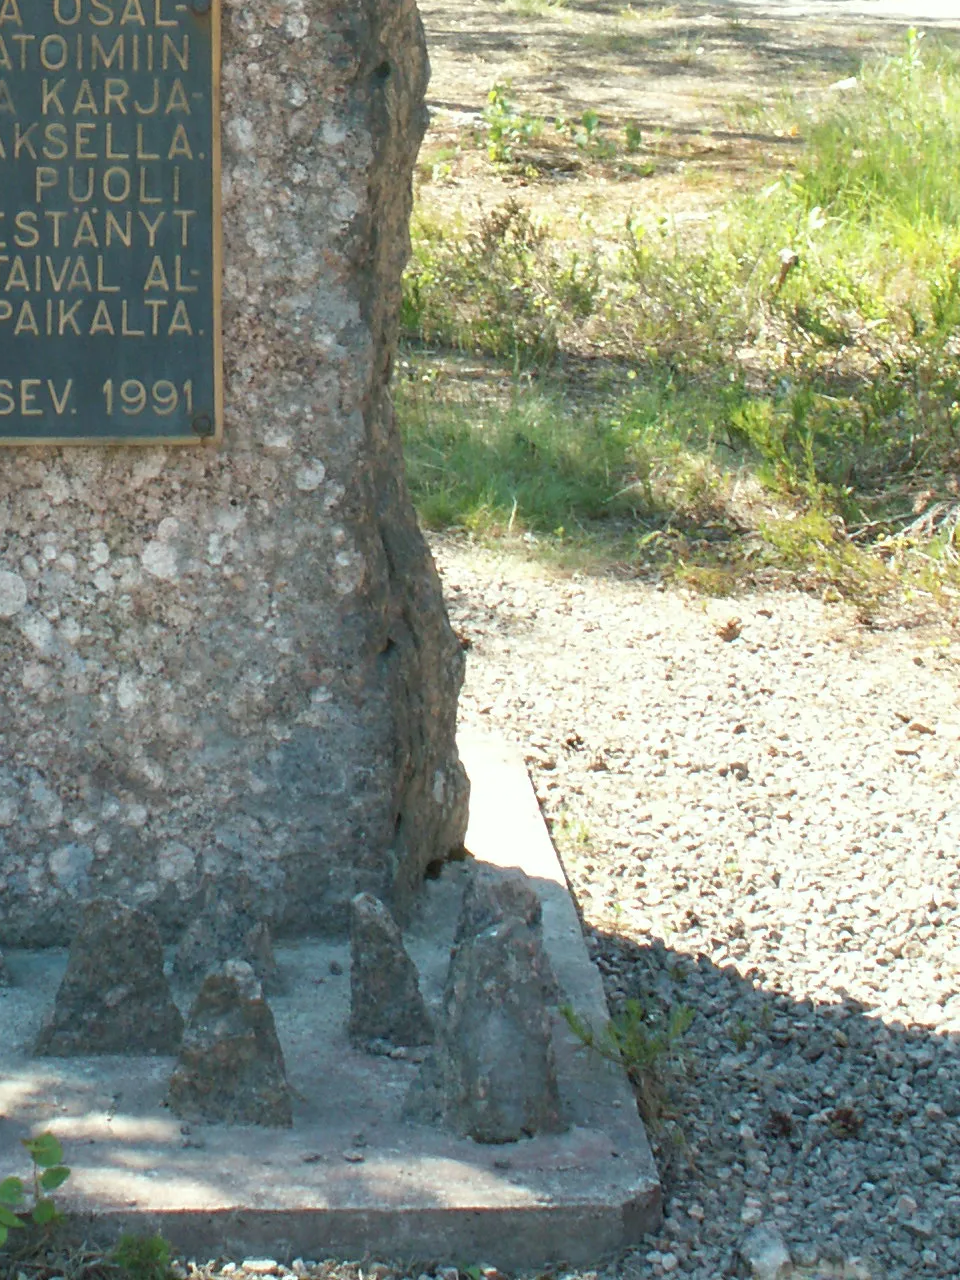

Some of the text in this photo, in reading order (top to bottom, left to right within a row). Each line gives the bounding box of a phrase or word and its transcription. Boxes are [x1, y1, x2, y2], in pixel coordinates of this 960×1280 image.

[42, 78, 204, 117] KARJA-
[36, 167, 180, 203] PUOLI
[144, 255, 200, 292] AL-
[104, 379, 193, 415] 1991
